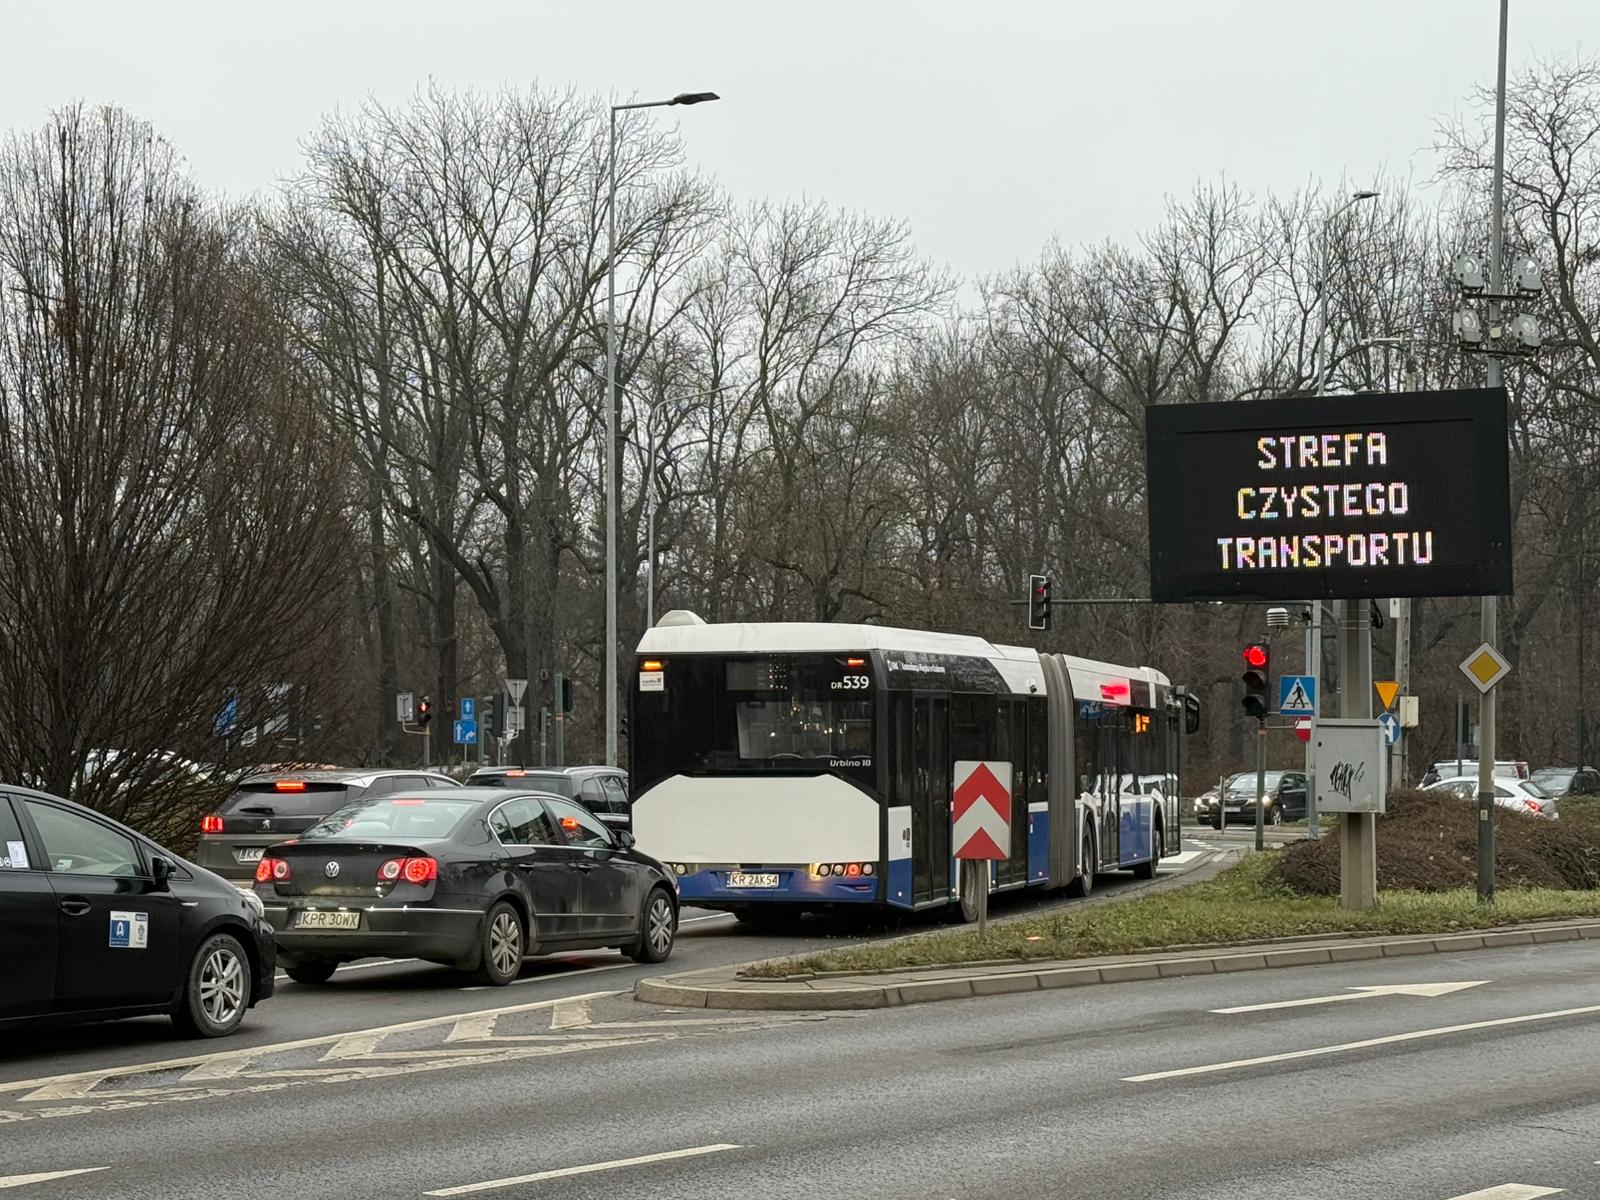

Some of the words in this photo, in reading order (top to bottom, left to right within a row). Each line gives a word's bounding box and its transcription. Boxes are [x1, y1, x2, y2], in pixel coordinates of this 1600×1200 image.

[1257, 432, 1387, 469] STREFA
[1237, 482, 1409, 520] CZYSTEGO
[1216, 531, 1433, 569] TRANSPORTU
[830, 759, 860, 767] Urbino
[731, 874, 746, 885] KR
[302, 913, 327, 926] KPR
[329, 913, 358, 927] 30WX
